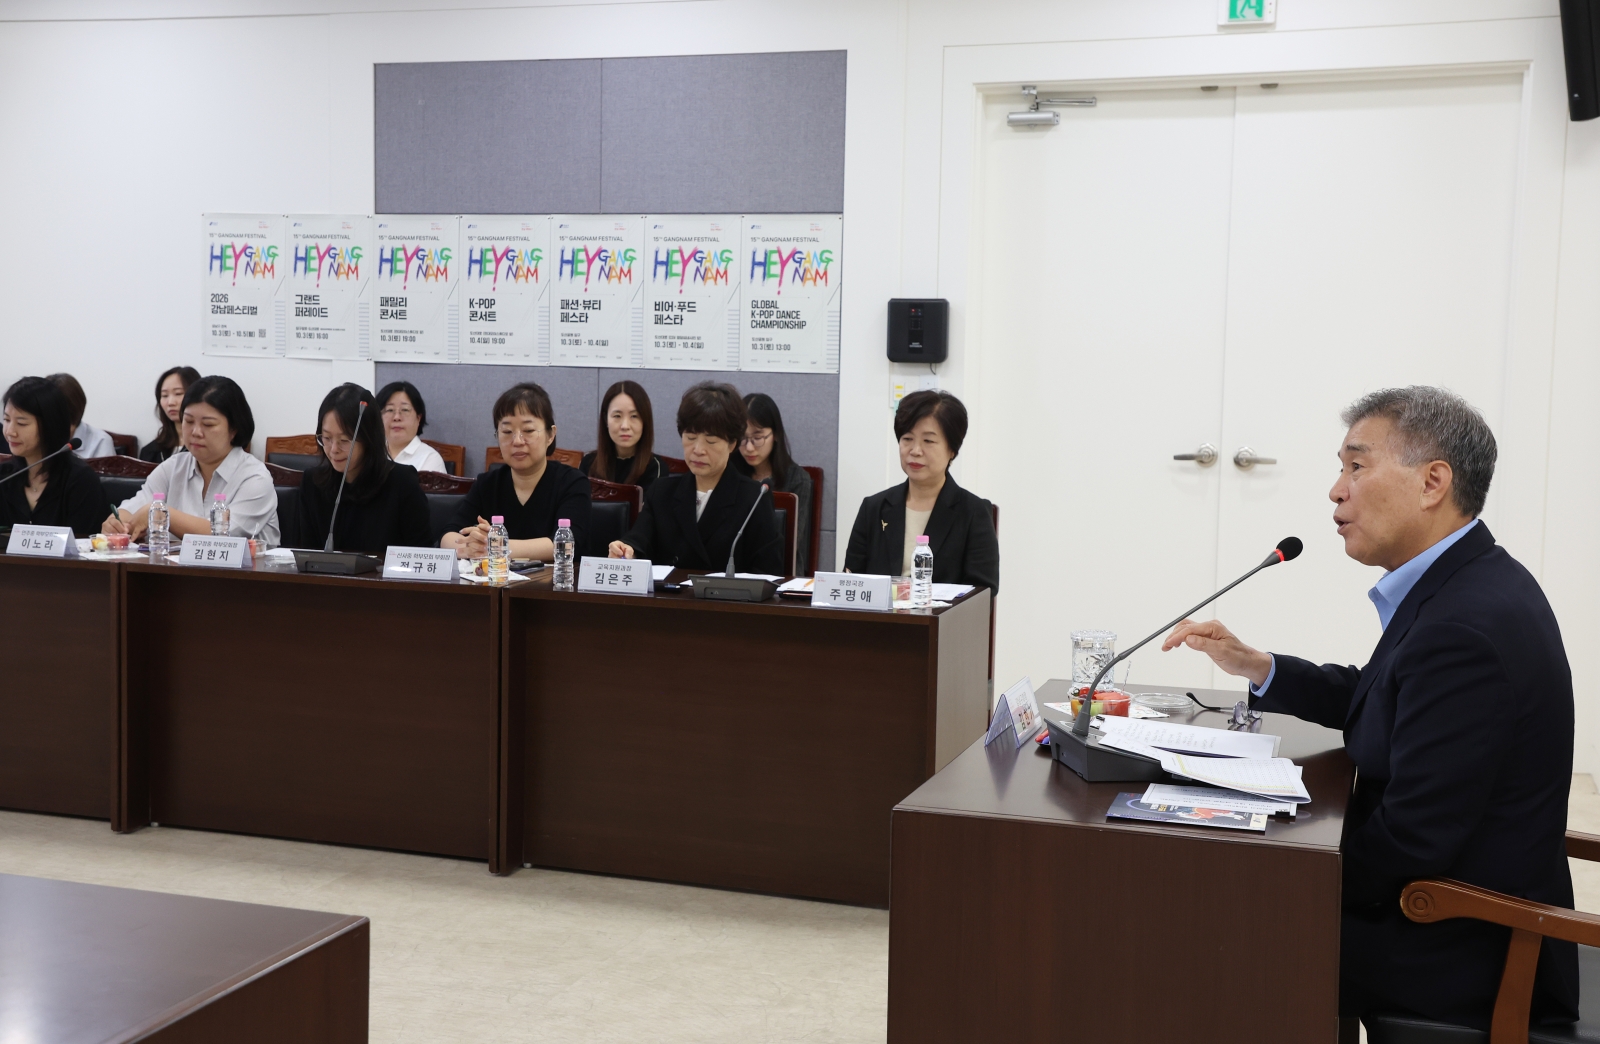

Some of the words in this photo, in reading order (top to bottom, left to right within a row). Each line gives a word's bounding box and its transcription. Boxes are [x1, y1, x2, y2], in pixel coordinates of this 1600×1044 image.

[244, 245, 278, 264] GANG
[328, 246, 363, 265] GANG
[416, 248, 452, 267] GANG
[506, 248, 543, 268] GANG
[598, 248, 636, 268] GANG
[694, 250, 733, 270] GANG
[792, 250, 833, 270] GANG
[245, 260, 274, 279] NAM
[328, 262, 358, 280] NAM
[416, 264, 448, 282] NAM
[506, 264, 538, 284] NAM
[598, 264, 632, 284] NAM
[694, 266, 728, 286] NAM
[792, 266, 828, 287] NAM
[210, 294, 228, 303] 2026
[295, 294, 320, 305] 그랜드
[380, 297, 407, 308] 패밀리
[469, 298, 496, 309] K-POP
[211, 305, 258, 316] 강남페스티벌
[560, 300, 602, 310] 패션·뷰티
[654, 301, 696, 312] 비어·푸드
[751, 300, 780, 310] GLOBAL
[295, 307, 328, 318] 퍼레이드
[380, 310, 407, 320] 콘서트
[469, 311, 496, 322] 콘서트
[560, 312, 588, 323] 페스타
[751, 310, 774, 319] K-POP
[776, 310, 800, 320] DANCE
[654, 314, 684, 326] 페스타
[750, 320, 806, 330] CHAMPIONSHIP
[598, 564, 632, 572] 교육지원과장
